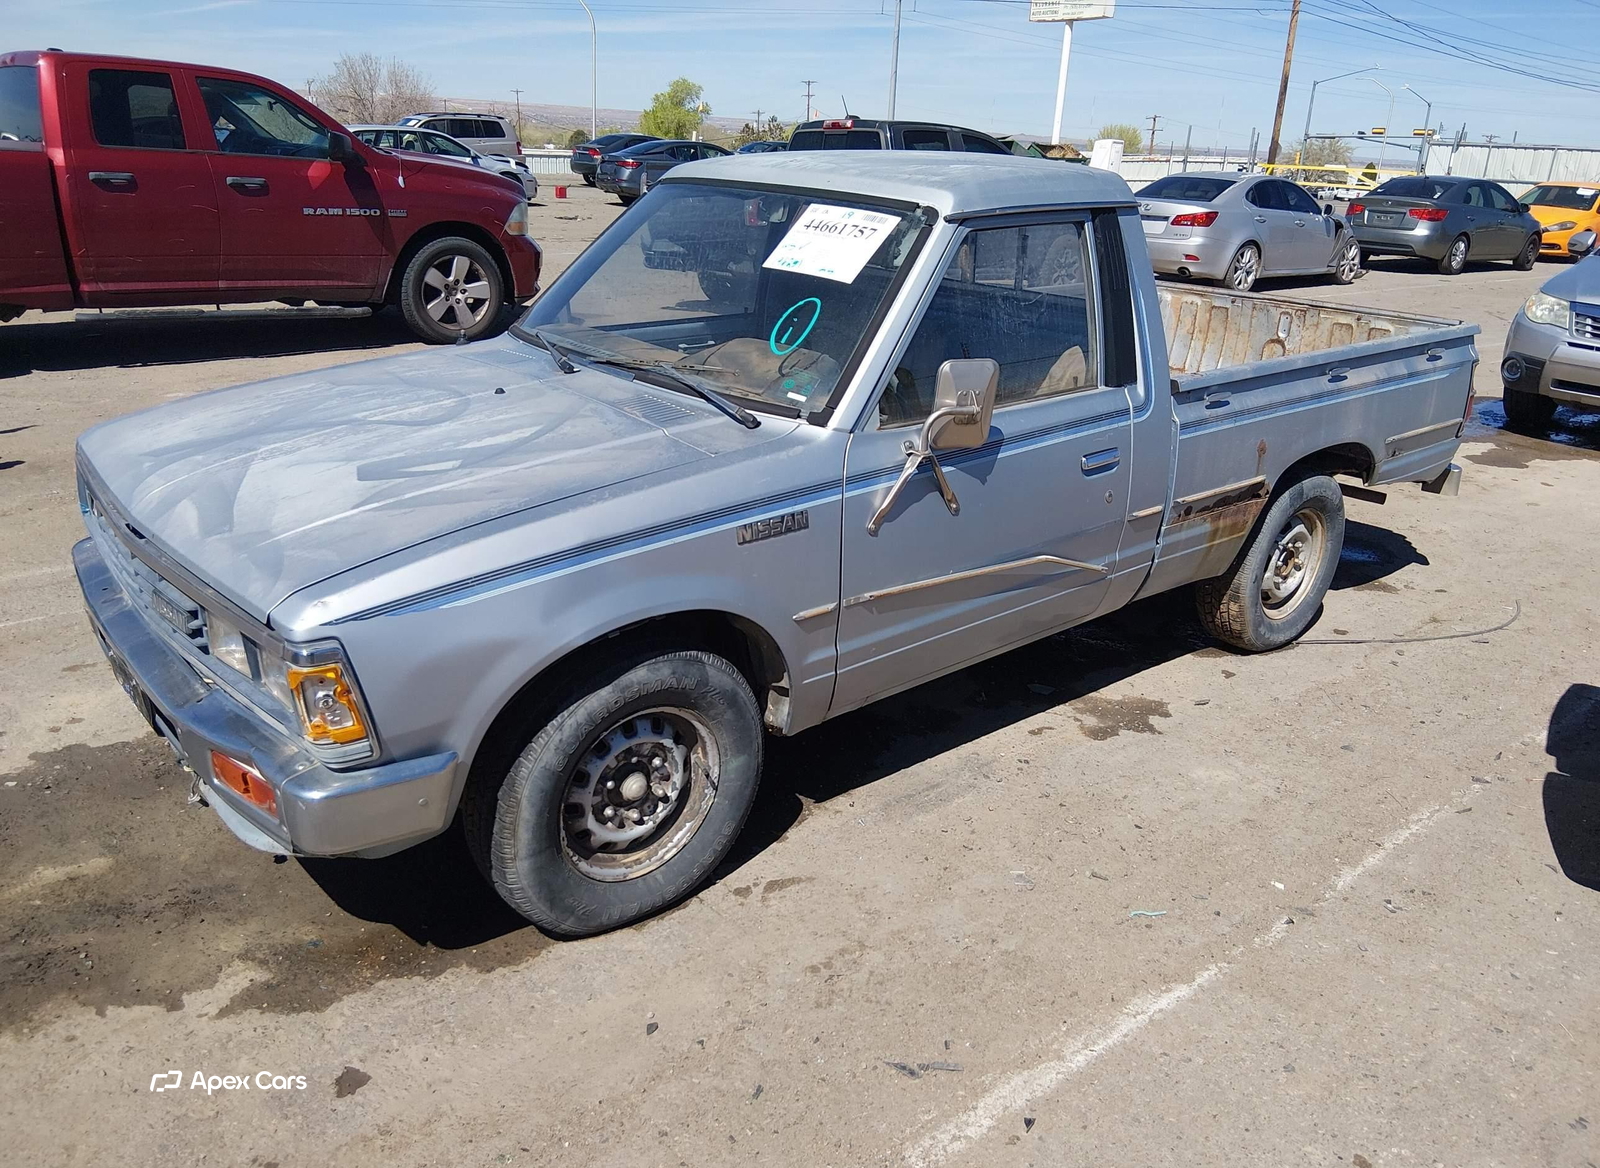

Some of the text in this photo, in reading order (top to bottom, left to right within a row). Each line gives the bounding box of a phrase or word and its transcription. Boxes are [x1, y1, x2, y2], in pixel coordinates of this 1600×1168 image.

[302, 207, 343, 215] RAM
[345, 208, 381, 216] 1500
[804, 218, 878, 240] 44661757
[736, 510, 809, 544] NISSAN
